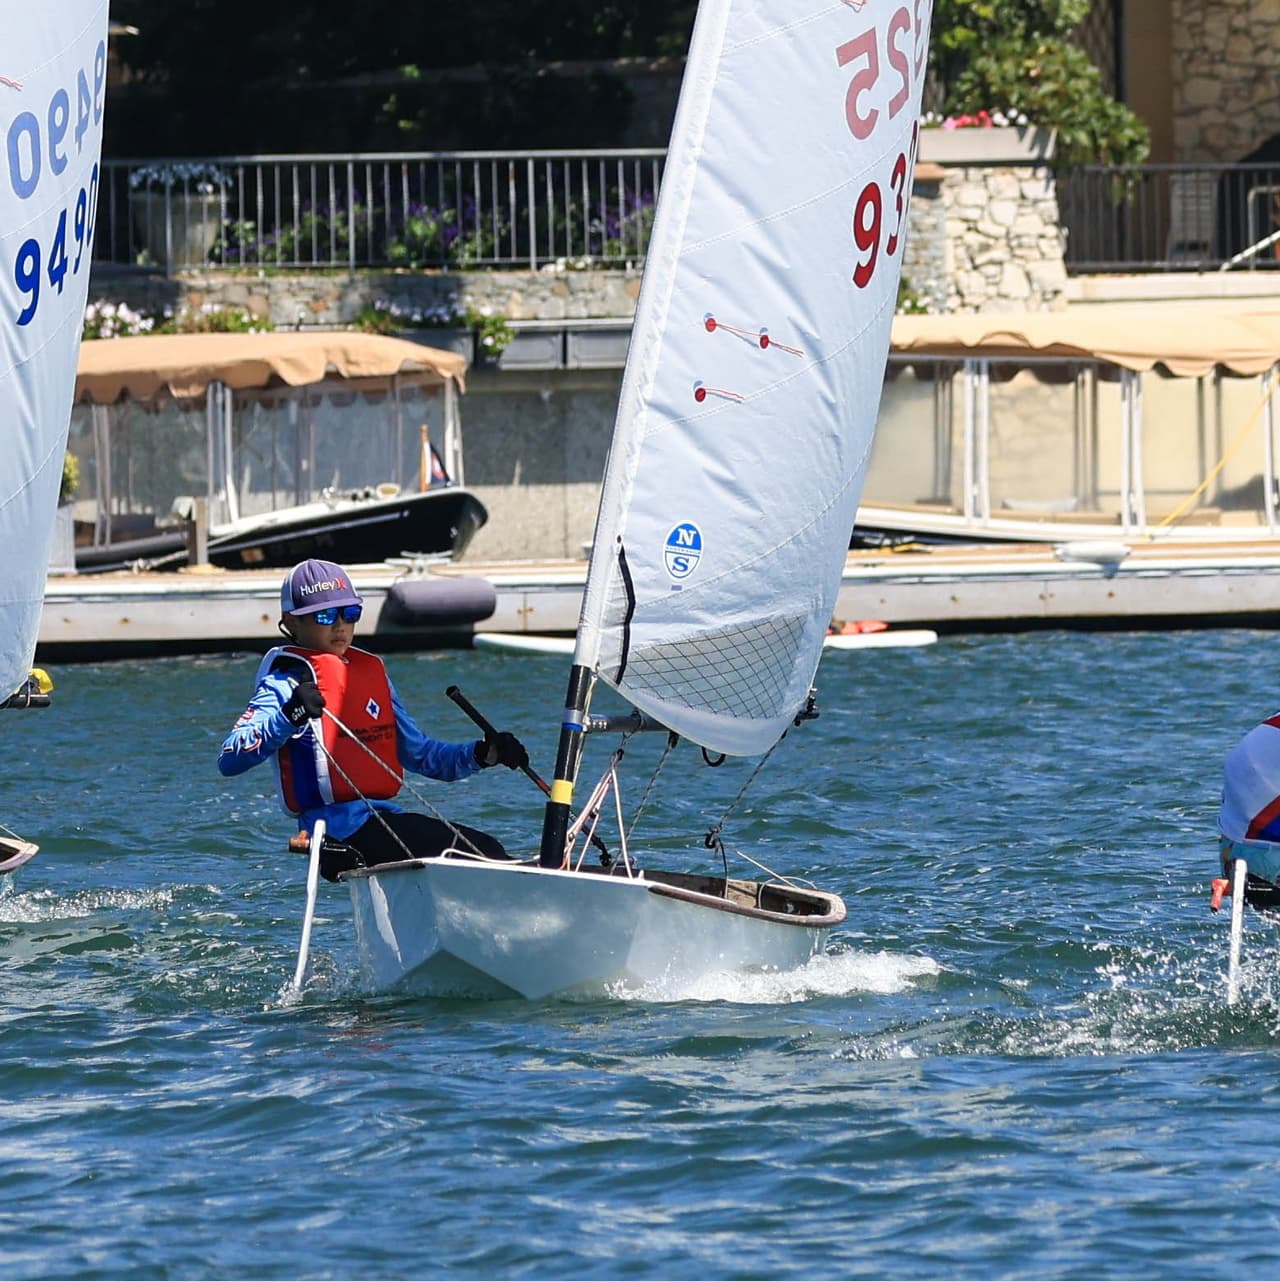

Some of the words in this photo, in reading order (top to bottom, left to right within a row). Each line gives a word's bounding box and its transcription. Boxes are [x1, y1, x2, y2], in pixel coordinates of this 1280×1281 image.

[14, 161, 99, 327] 9490
[675, 527, 697, 547] N
[672, 556, 690, 572] S
[300, 579, 336, 597] Hurley
[291, 704, 307, 721] Gill
